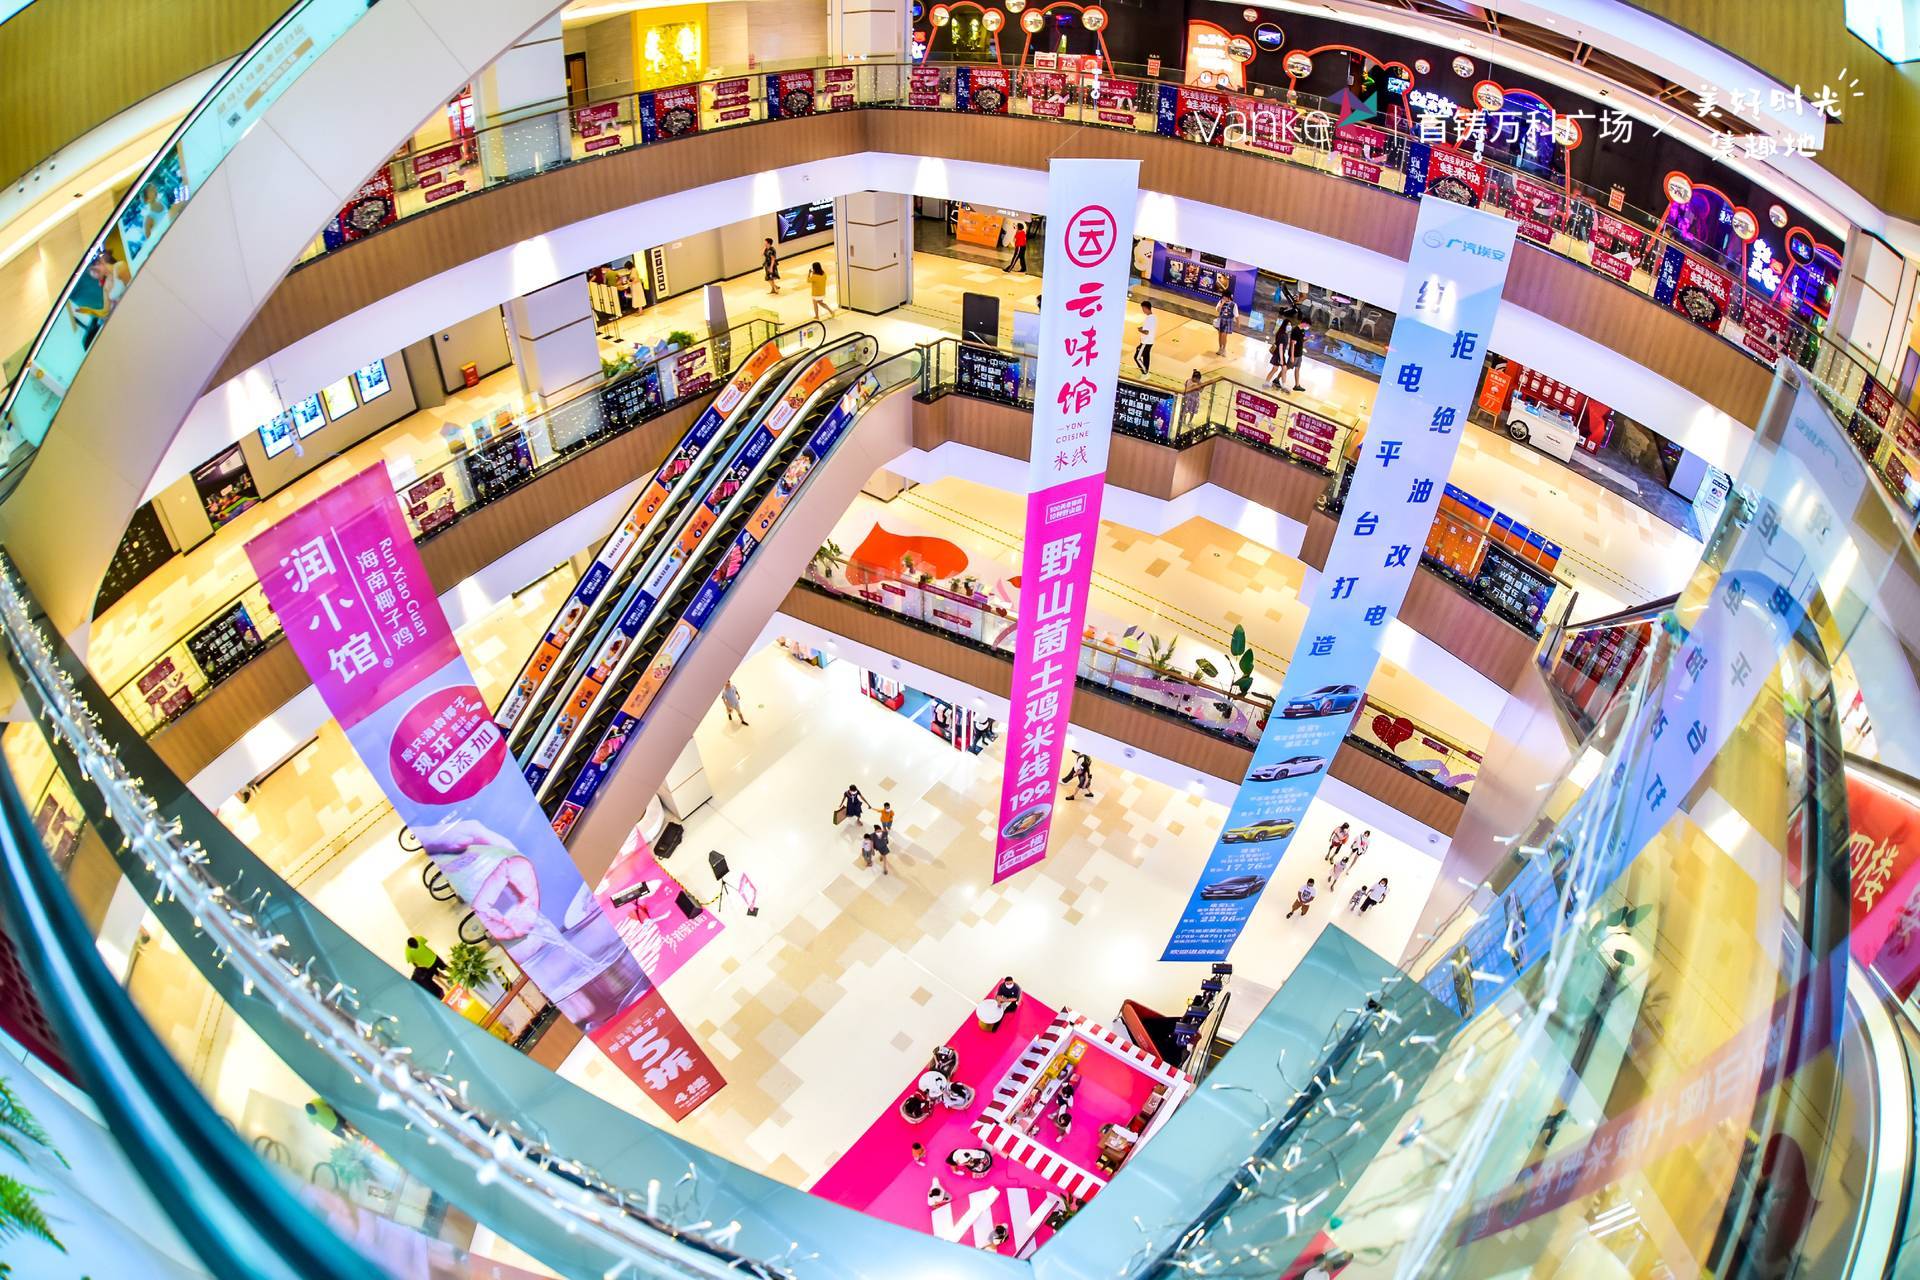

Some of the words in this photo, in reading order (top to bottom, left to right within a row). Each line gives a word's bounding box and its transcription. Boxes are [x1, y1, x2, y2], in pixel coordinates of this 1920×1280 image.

[1445, 237, 1506, 263] 广汽埃安
[1057, 282, 1104, 416] 云味馆
[1053, 445, 1088, 471] 米线
[279, 534, 380, 685] 润小馆
[356, 548, 415, 651] 海南椰子鸡
[378, 536, 395, 567] Run
[393, 567, 412, 600] Xiao
[404, 599, 429, 637] Guan
[1016, 531, 1082, 789] 野山菌土鸡米线
[411, 733, 454, 776] 现开
